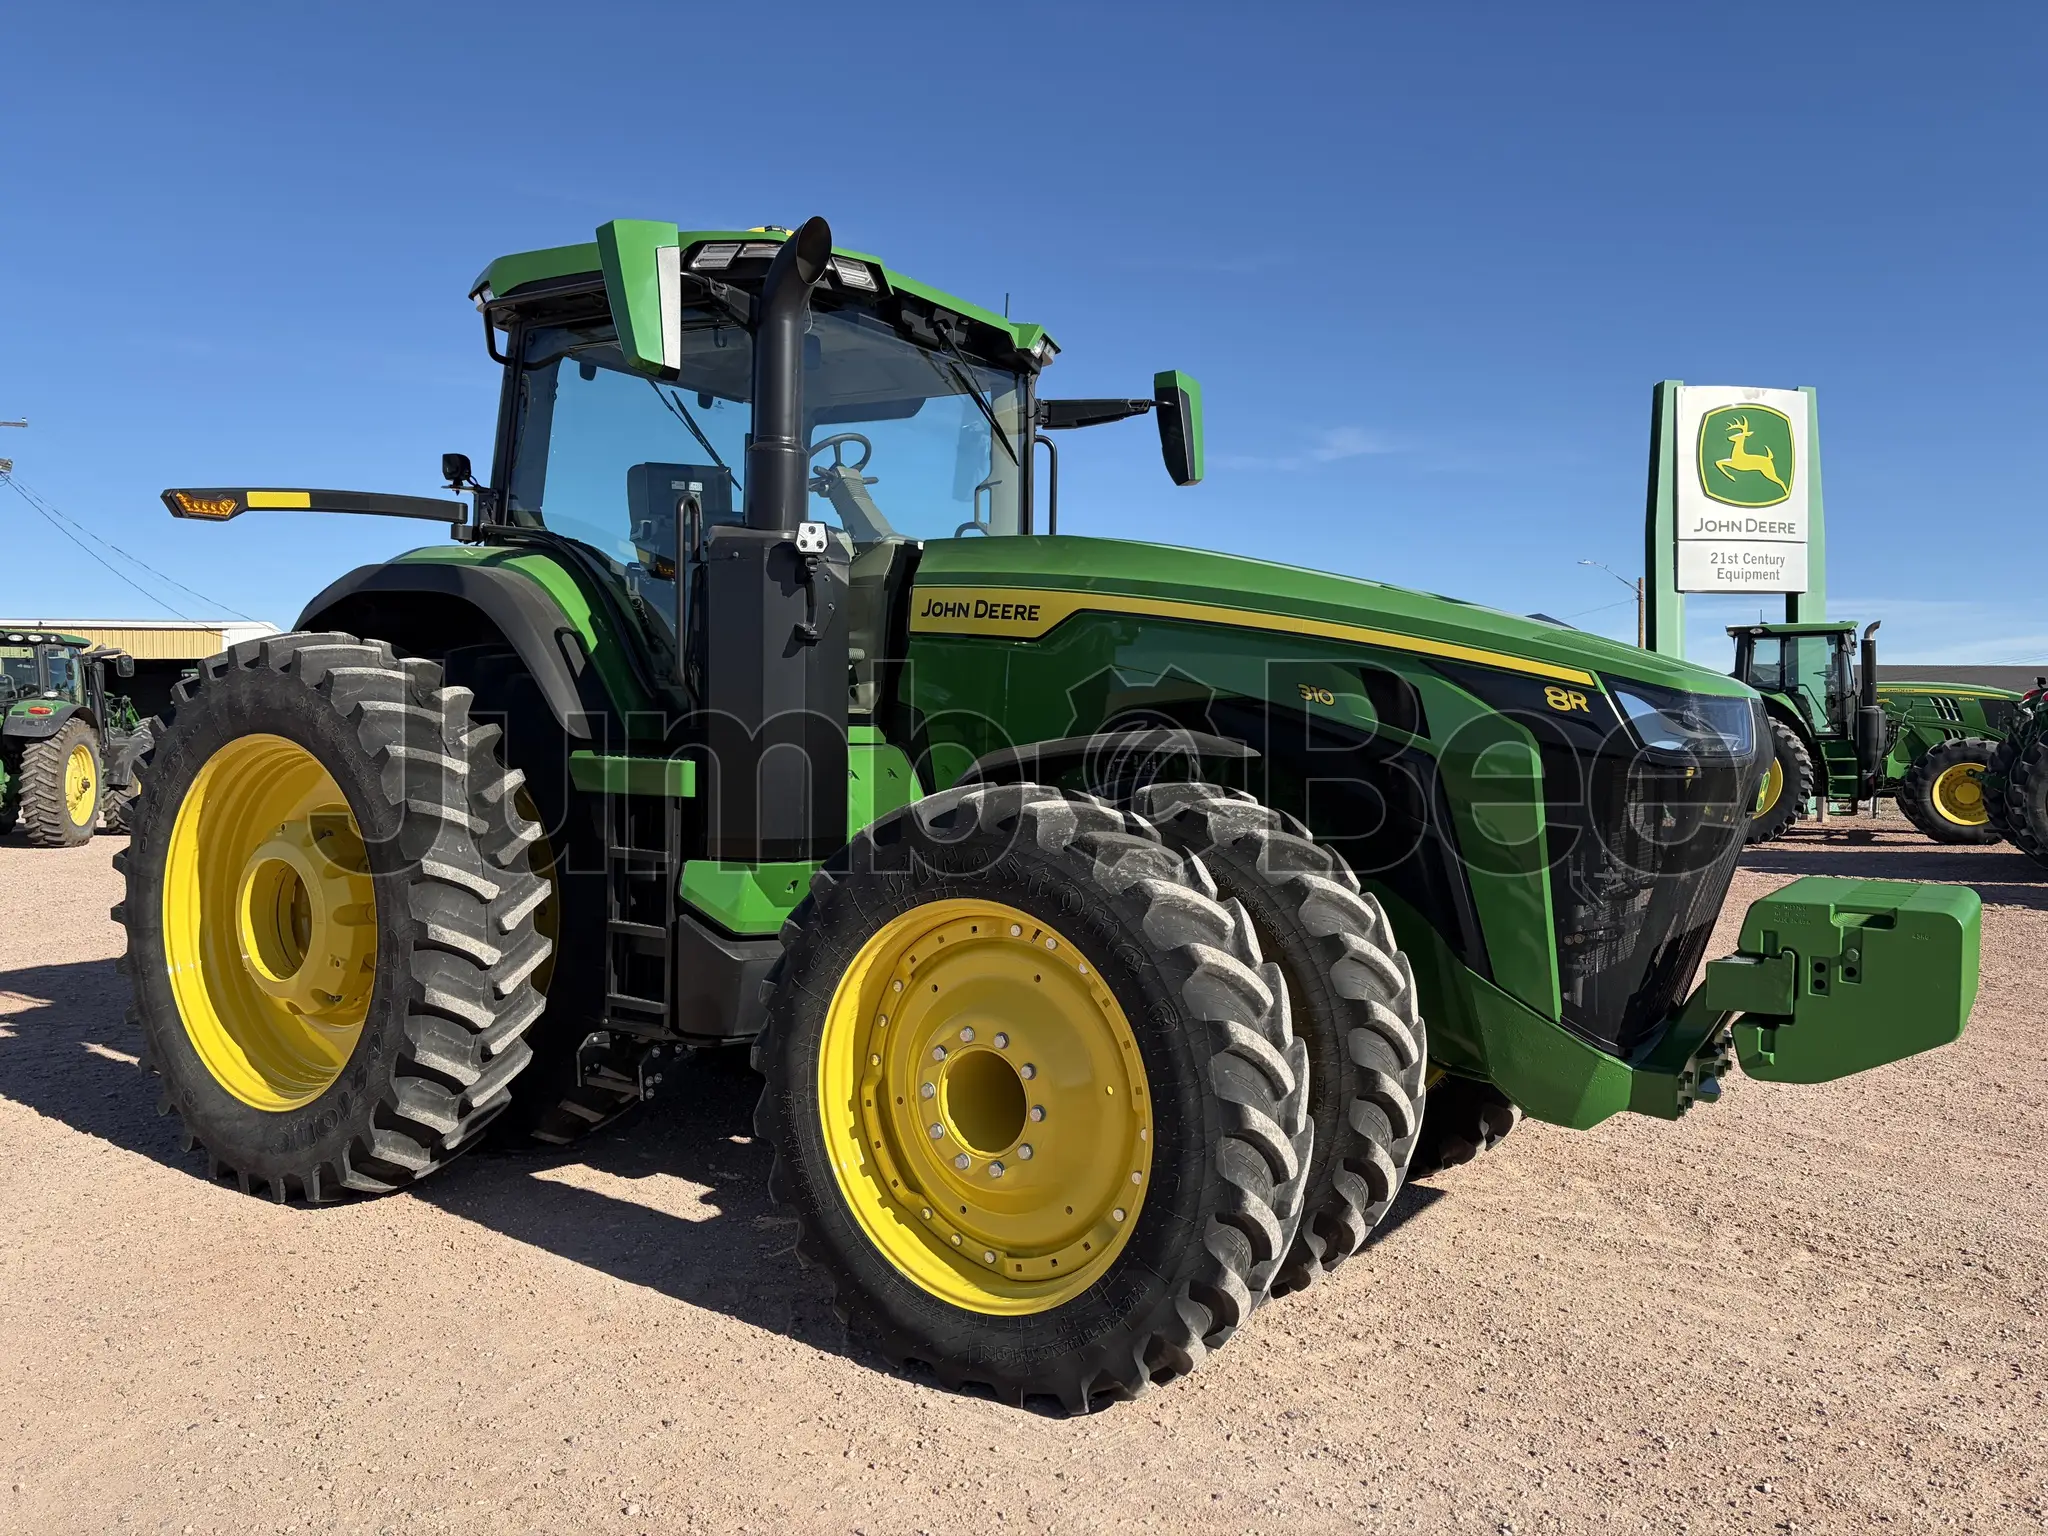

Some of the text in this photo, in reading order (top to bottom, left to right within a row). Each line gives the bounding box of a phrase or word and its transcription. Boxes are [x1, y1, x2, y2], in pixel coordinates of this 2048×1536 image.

[1694, 517, 1796, 535] JOHN DEERE
[1710, 552, 1786, 568] 21st Century
[1717, 567, 1780, 583] Equipment
[921, 598, 1041, 622] JOHN DEERE
[1297, 683, 1336, 706] 310
[1544, 685, 1591, 713] 8R
